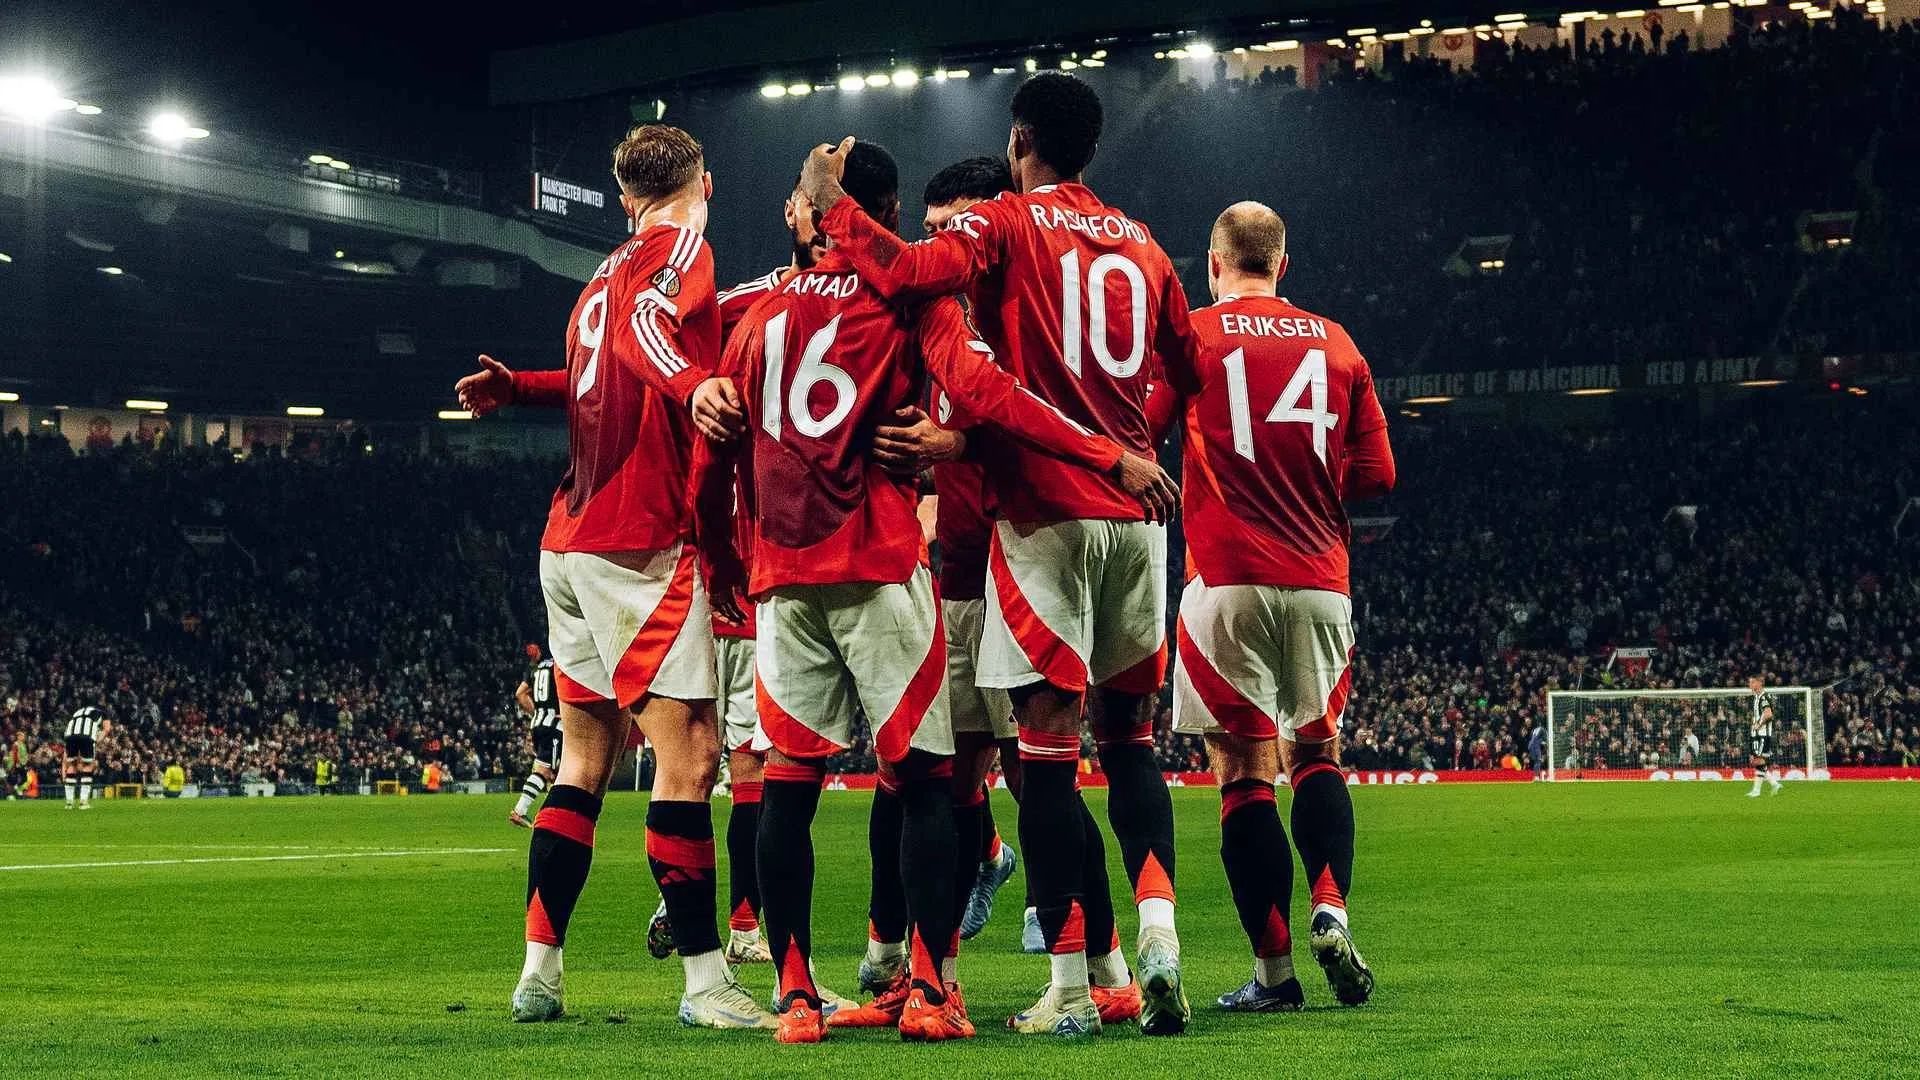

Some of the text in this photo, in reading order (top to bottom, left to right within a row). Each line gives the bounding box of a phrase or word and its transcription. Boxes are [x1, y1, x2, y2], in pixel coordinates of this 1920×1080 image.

[541, 177, 603, 208] MANCHESTER UNITED
[541, 194, 567, 216] PAOK FC
[1029, 204, 1148, 245] RASHFORD
[783, 273, 858, 299] AMAD
[1060, 247, 1148, 380] 10
[1220, 313, 1328, 340] ERIKSEN
[577, 285, 608, 401] 9
[762, 308, 858, 442] 16
[1473, 369, 1497, 394] OF
[1222, 346, 1339, 466] 14
[533, 668, 549, 702] 19
